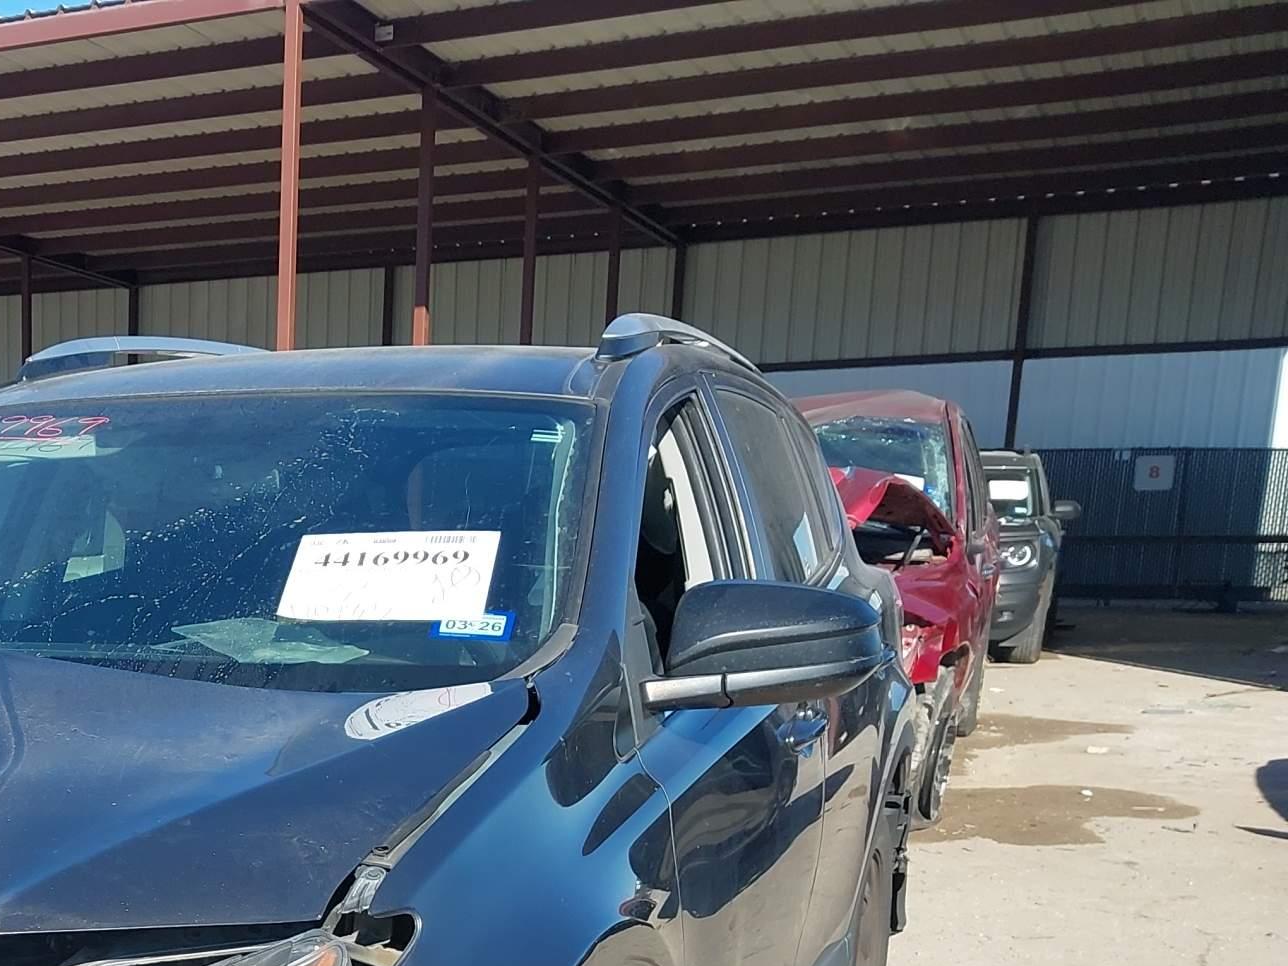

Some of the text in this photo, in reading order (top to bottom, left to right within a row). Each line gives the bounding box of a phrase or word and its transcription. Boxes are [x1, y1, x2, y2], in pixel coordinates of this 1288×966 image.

[1148, 465, 1160, 479] 8
[314, 549, 470, 567] 44169969
[445, 619, 503, 632] 03 26
